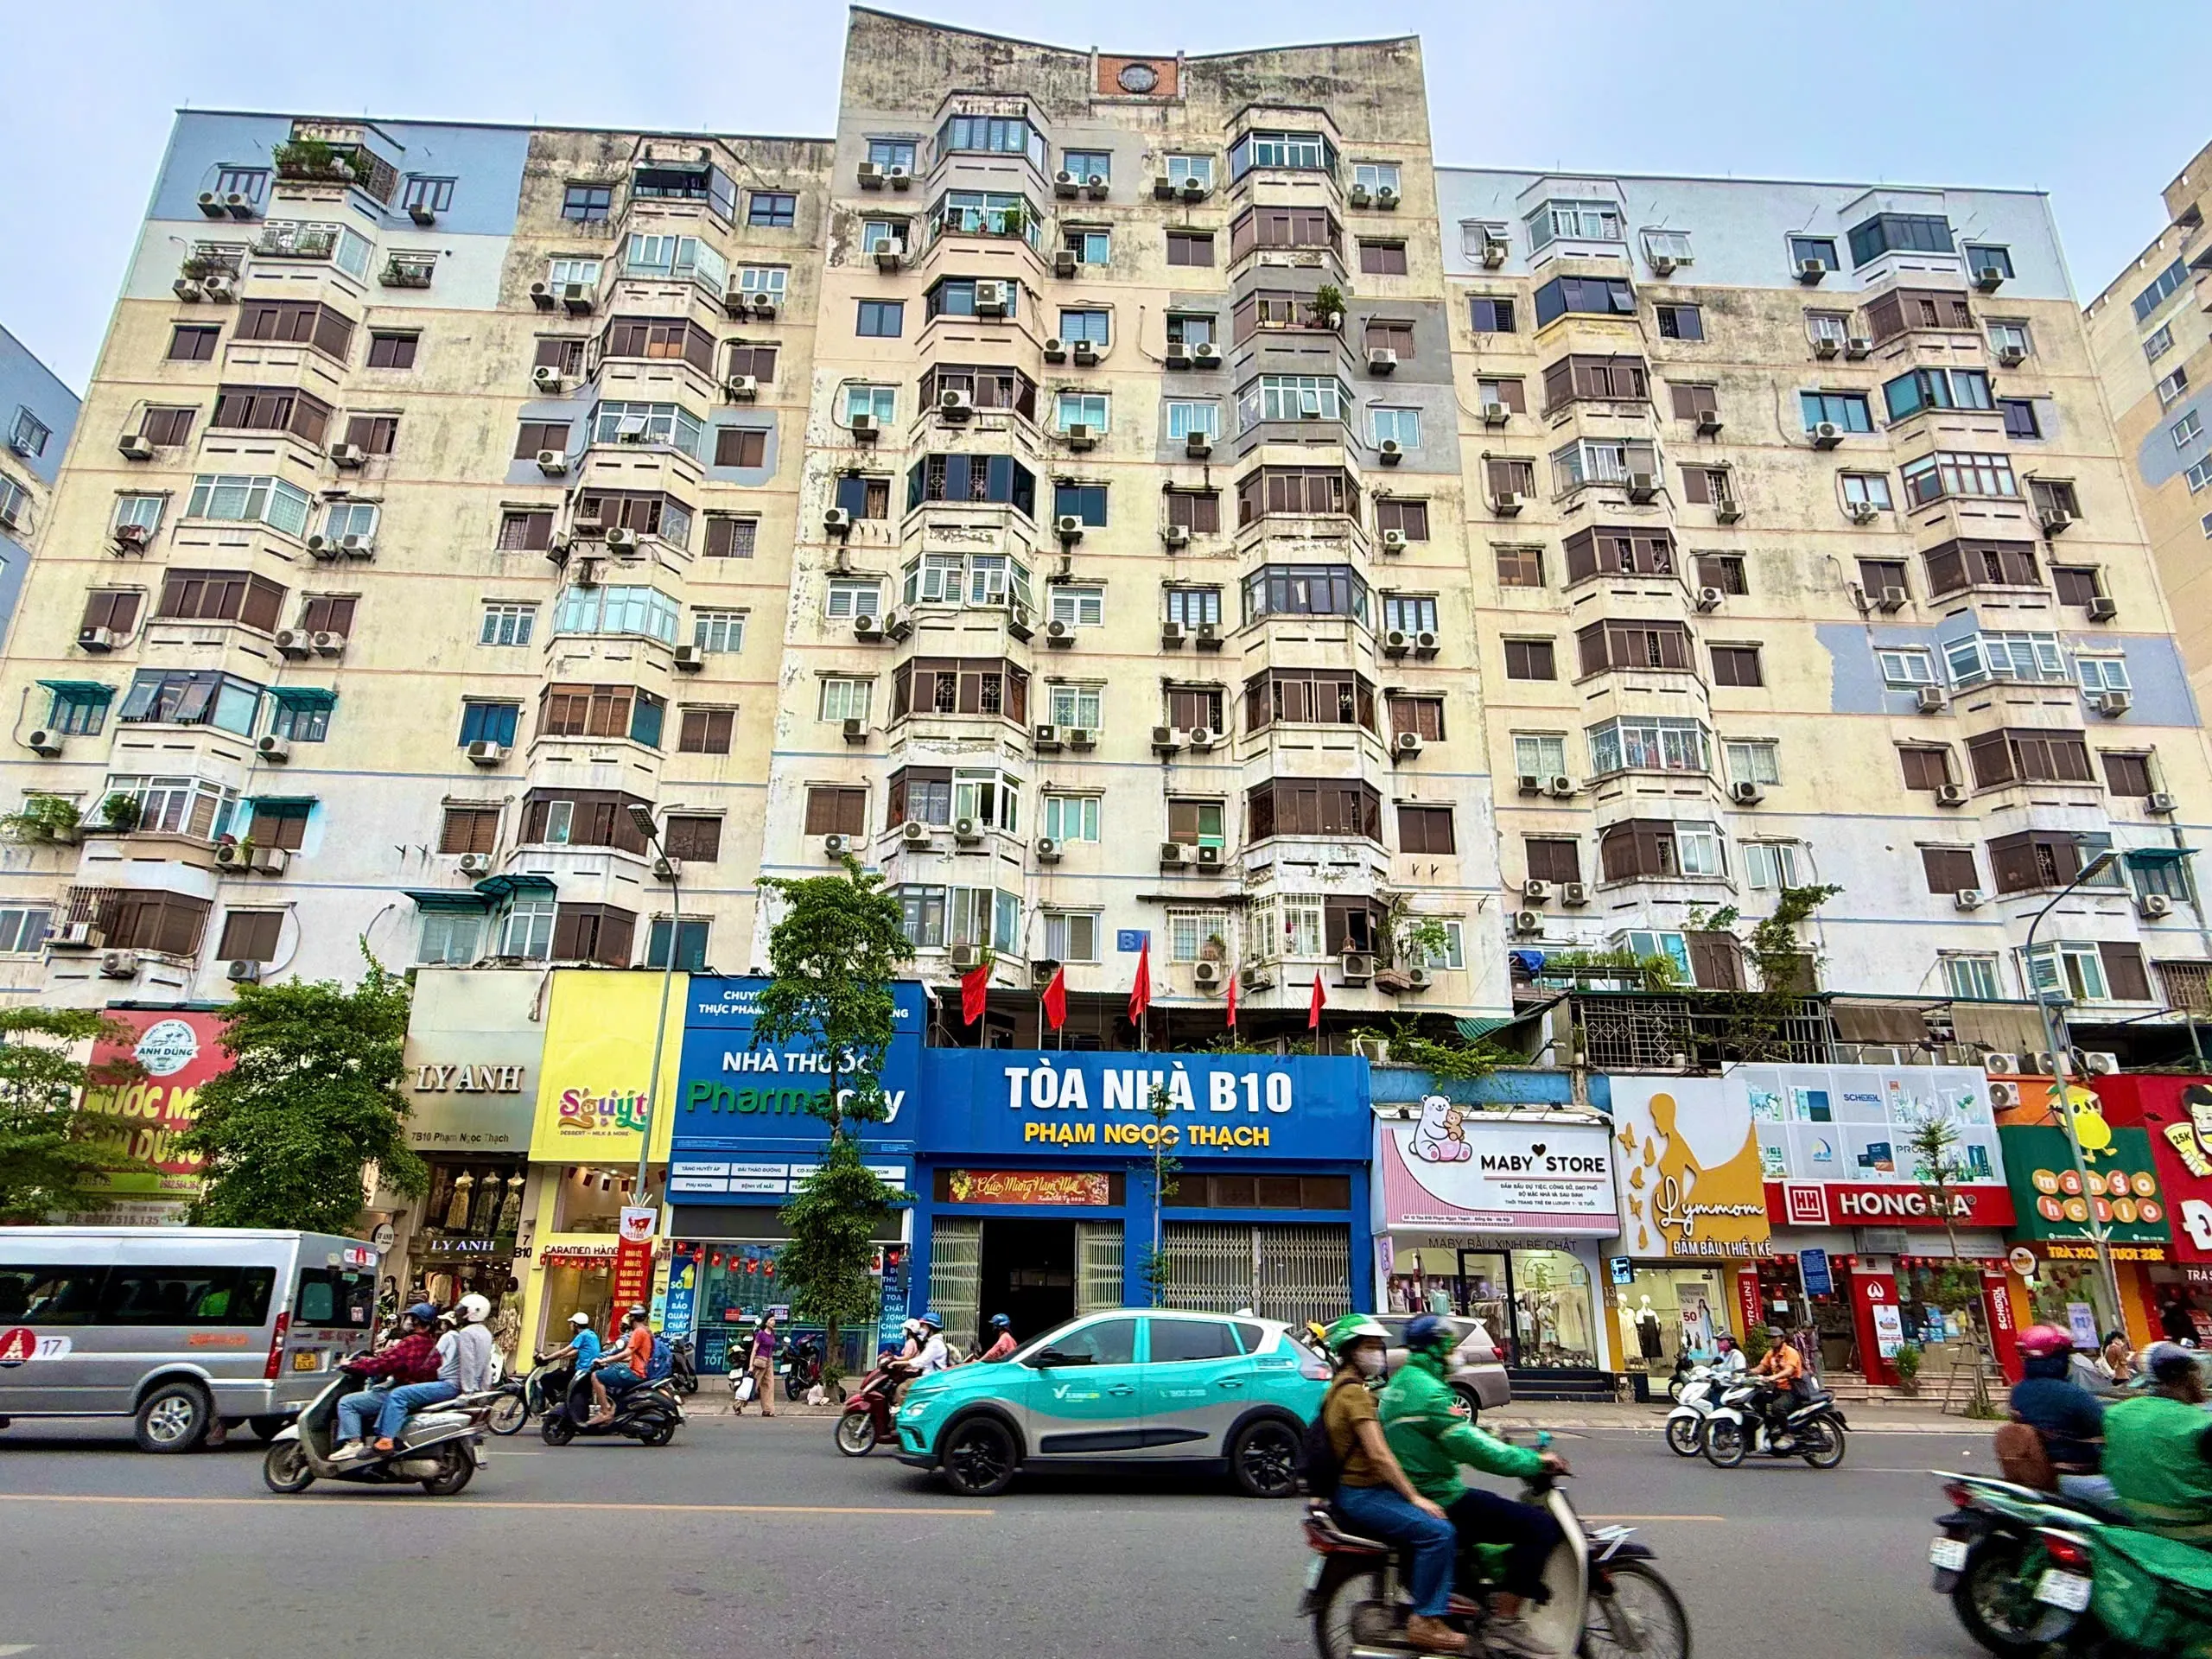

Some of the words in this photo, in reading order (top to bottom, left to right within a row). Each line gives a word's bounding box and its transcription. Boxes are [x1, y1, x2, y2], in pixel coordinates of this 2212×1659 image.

[722, 1048, 779, 1072] NHÀ
[415, 1065, 454, 1092] LY
[454, 1065, 523, 1092] ANH
[1005, 1058, 1088, 1109] TÒA
[1103, 1061, 1196, 1111] NHÀ
[1209, 1071, 1293, 1113] B10
[1024, 1123, 1095, 1147] PHẠM
[1104, 1124, 1179, 1150] NGỌC
[1190, 1125, 1270, 1151] THẠCH
[2172, 1130, 2192, 1145] 25K
[1481, 1154, 1533, 1172] MABY
[1546, 1155, 1606, 1173] STORE
[2038, 1173, 2150, 1193] mango
[2045, 1199, 2158, 1219] hello
[431, 1240, 454, 1250] LY
[455, 1241, 496, 1251] ANH
[523, 1235, 531, 1245] 7
[1428, 1238, 1463, 1249] MABY
[1495, 1240, 1522, 1249] XINH
[1673, 1236, 1698, 1255] ĐẦM
[1700, 1236, 1723, 1255] BẦU
[1724, 1235, 1755, 1256] THIẾT
[1757, 1236, 1773, 1257] KẾ
[513, 1247, 532, 1258] B10
[544, 1245, 591, 1254] CARAMEN
[680, 1264, 695, 1289] 1
[1604, 1287, 1615, 1297] 13
[1683, 1312, 1697, 1321] 50
[43, 1340, 62, 1355] 17
